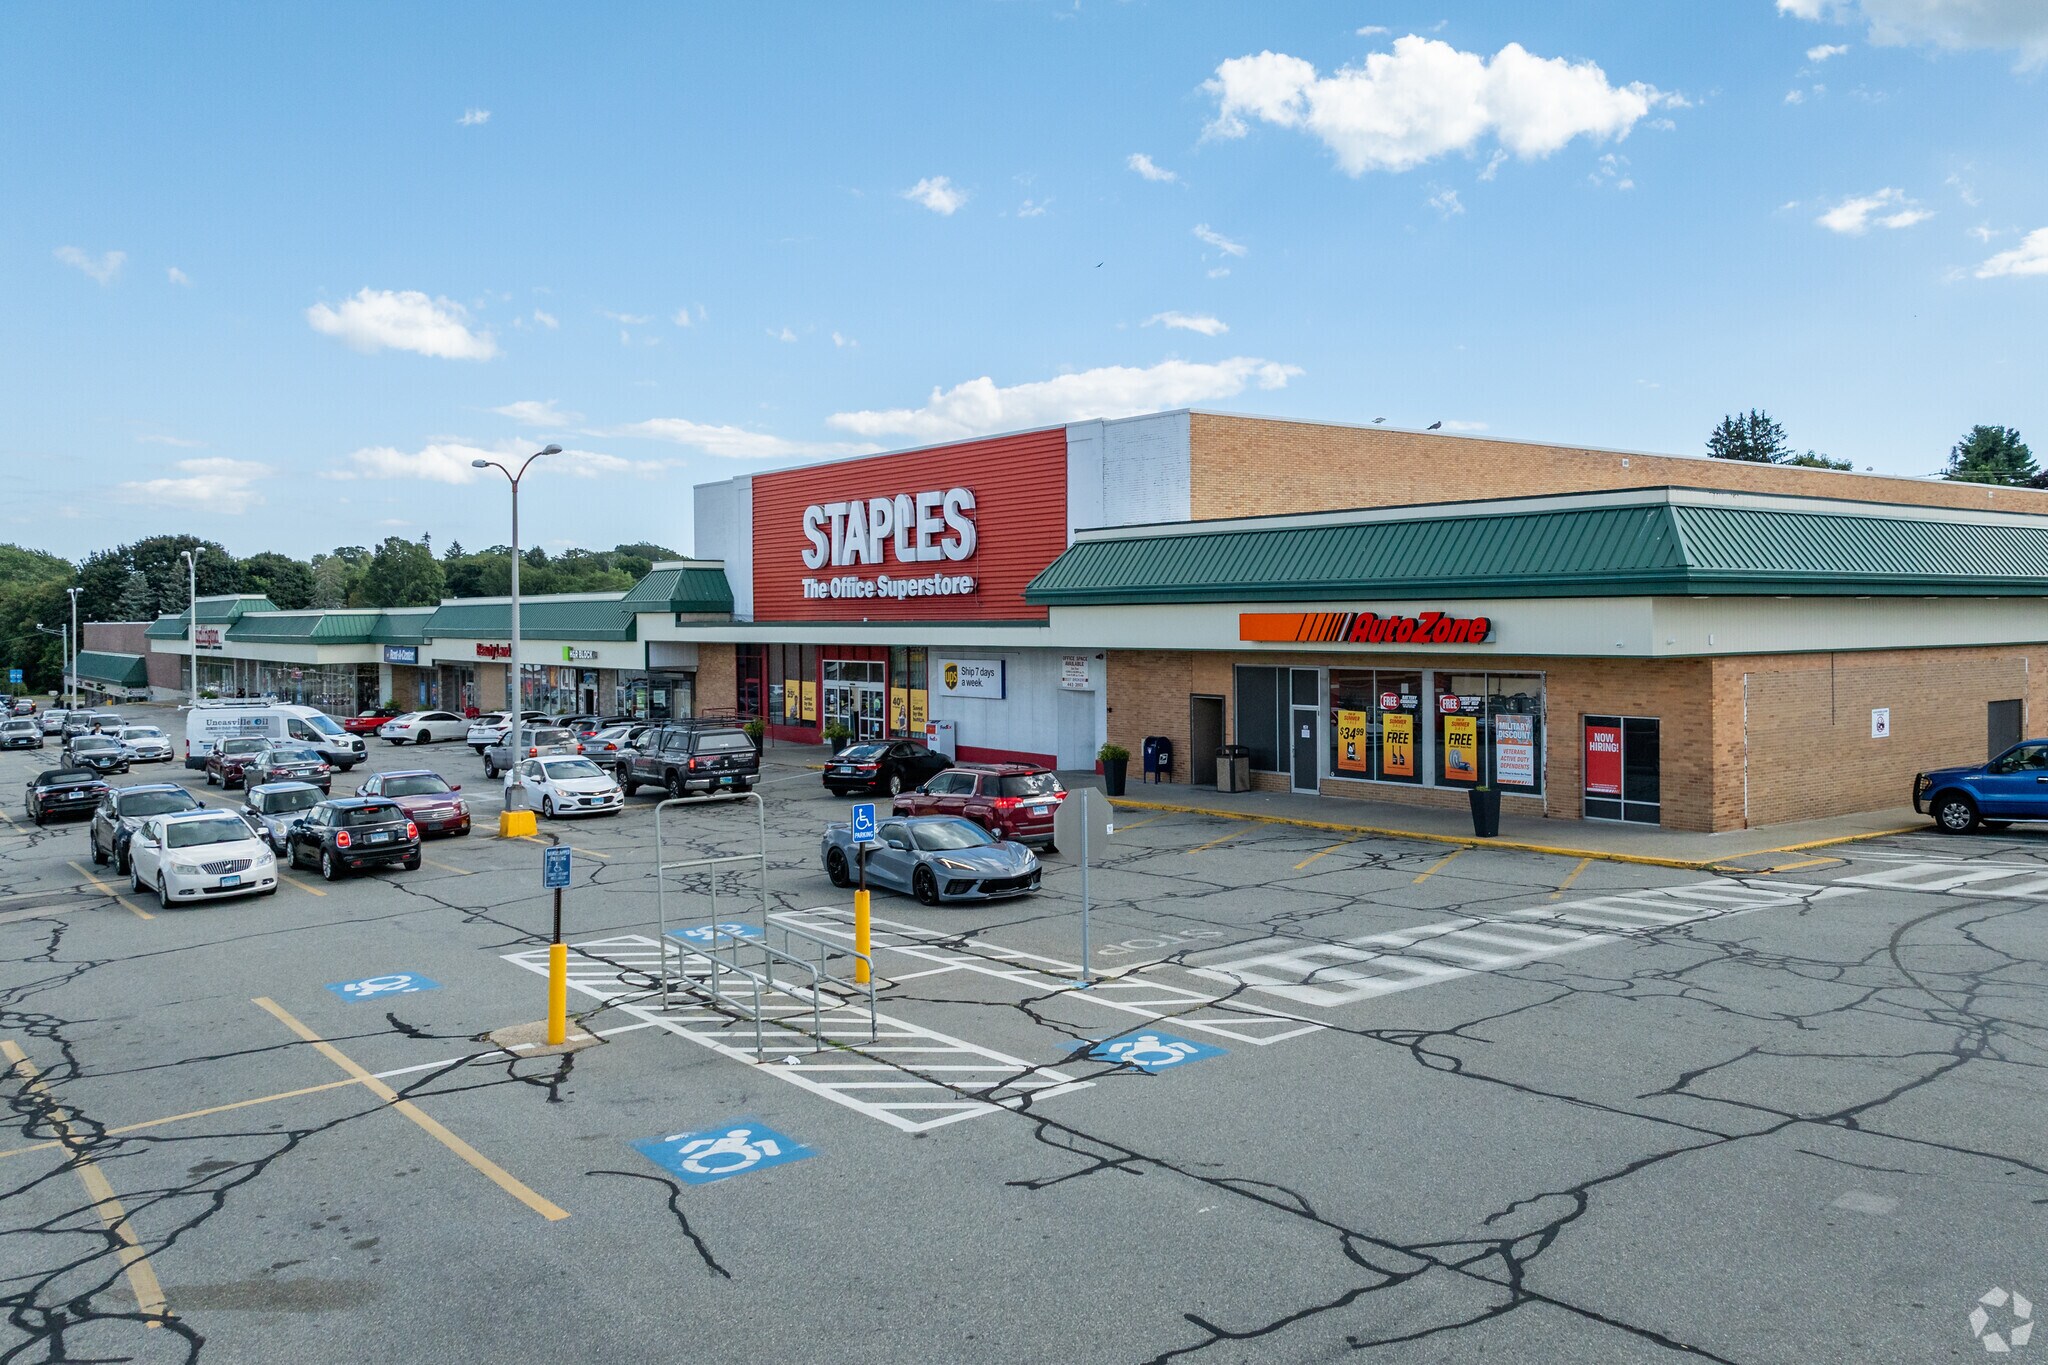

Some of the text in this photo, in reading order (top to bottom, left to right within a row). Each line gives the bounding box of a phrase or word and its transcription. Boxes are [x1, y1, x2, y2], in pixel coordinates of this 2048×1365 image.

[801, 487, 977, 570] STAPLES
[802, 574, 975, 600] The Office Superstore
[1351, 611, 1491, 644] AutoZone
[578, 650, 595, 659] BLOCK
[961, 666, 995, 677] Ship 7 days
[944, 671, 958, 687] ups
[966, 679, 984, 687] week.
[1383, 696, 1397, 707] FREE
[1442, 698, 1457, 709] FREE
[206, 718, 269, 726] Uncasville Oil
[1498, 721, 1529, 731] MILITARY
[1387, 732, 1409, 744] FREE
[1448, 733, 1473, 746] FREE
[1498, 730, 1530, 739] DISCOUNT
[1594, 733, 1614, 743] NOW
[1589, 742, 1619, 753] HIRING!
[855, 830, 874, 839] PARKING
